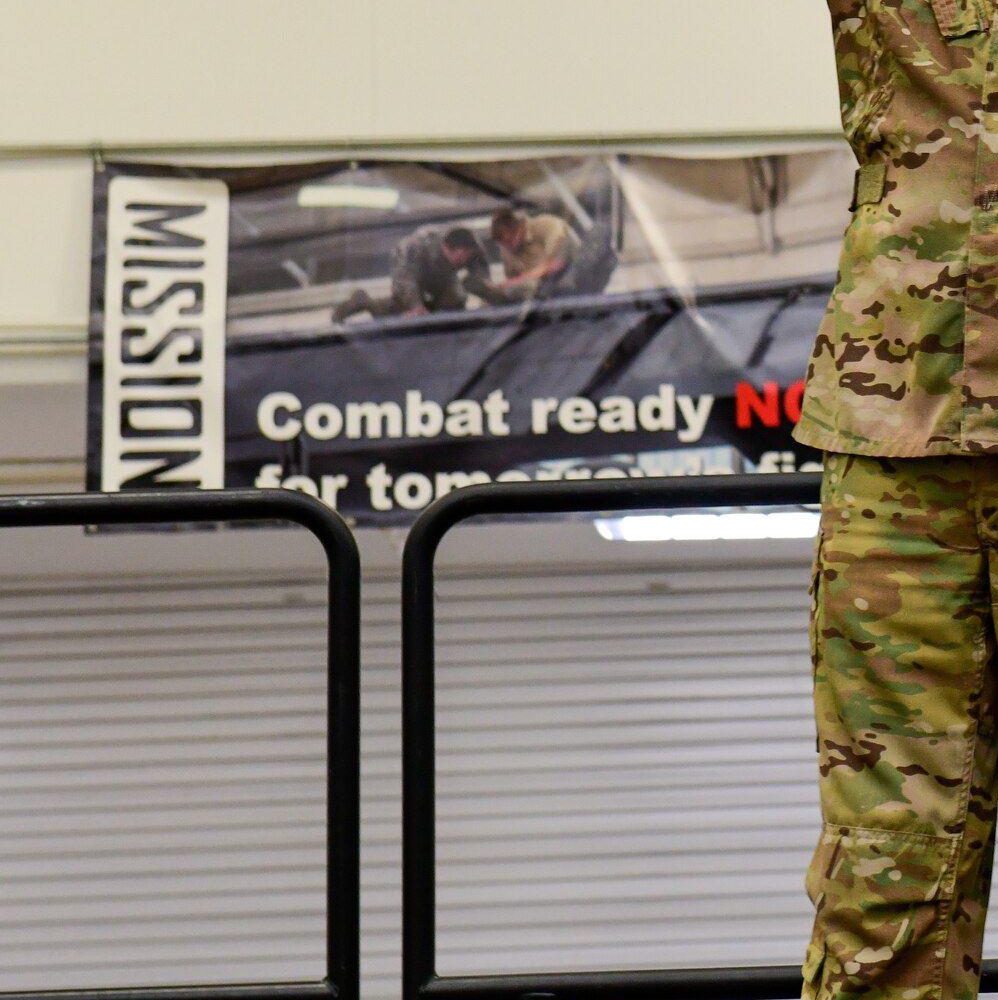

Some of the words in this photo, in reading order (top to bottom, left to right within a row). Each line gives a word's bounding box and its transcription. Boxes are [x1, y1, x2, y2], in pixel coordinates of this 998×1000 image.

[120, 203, 206, 488] MISSION
[257, 389, 510, 441] Combat
[532, 384, 714, 442] ready
